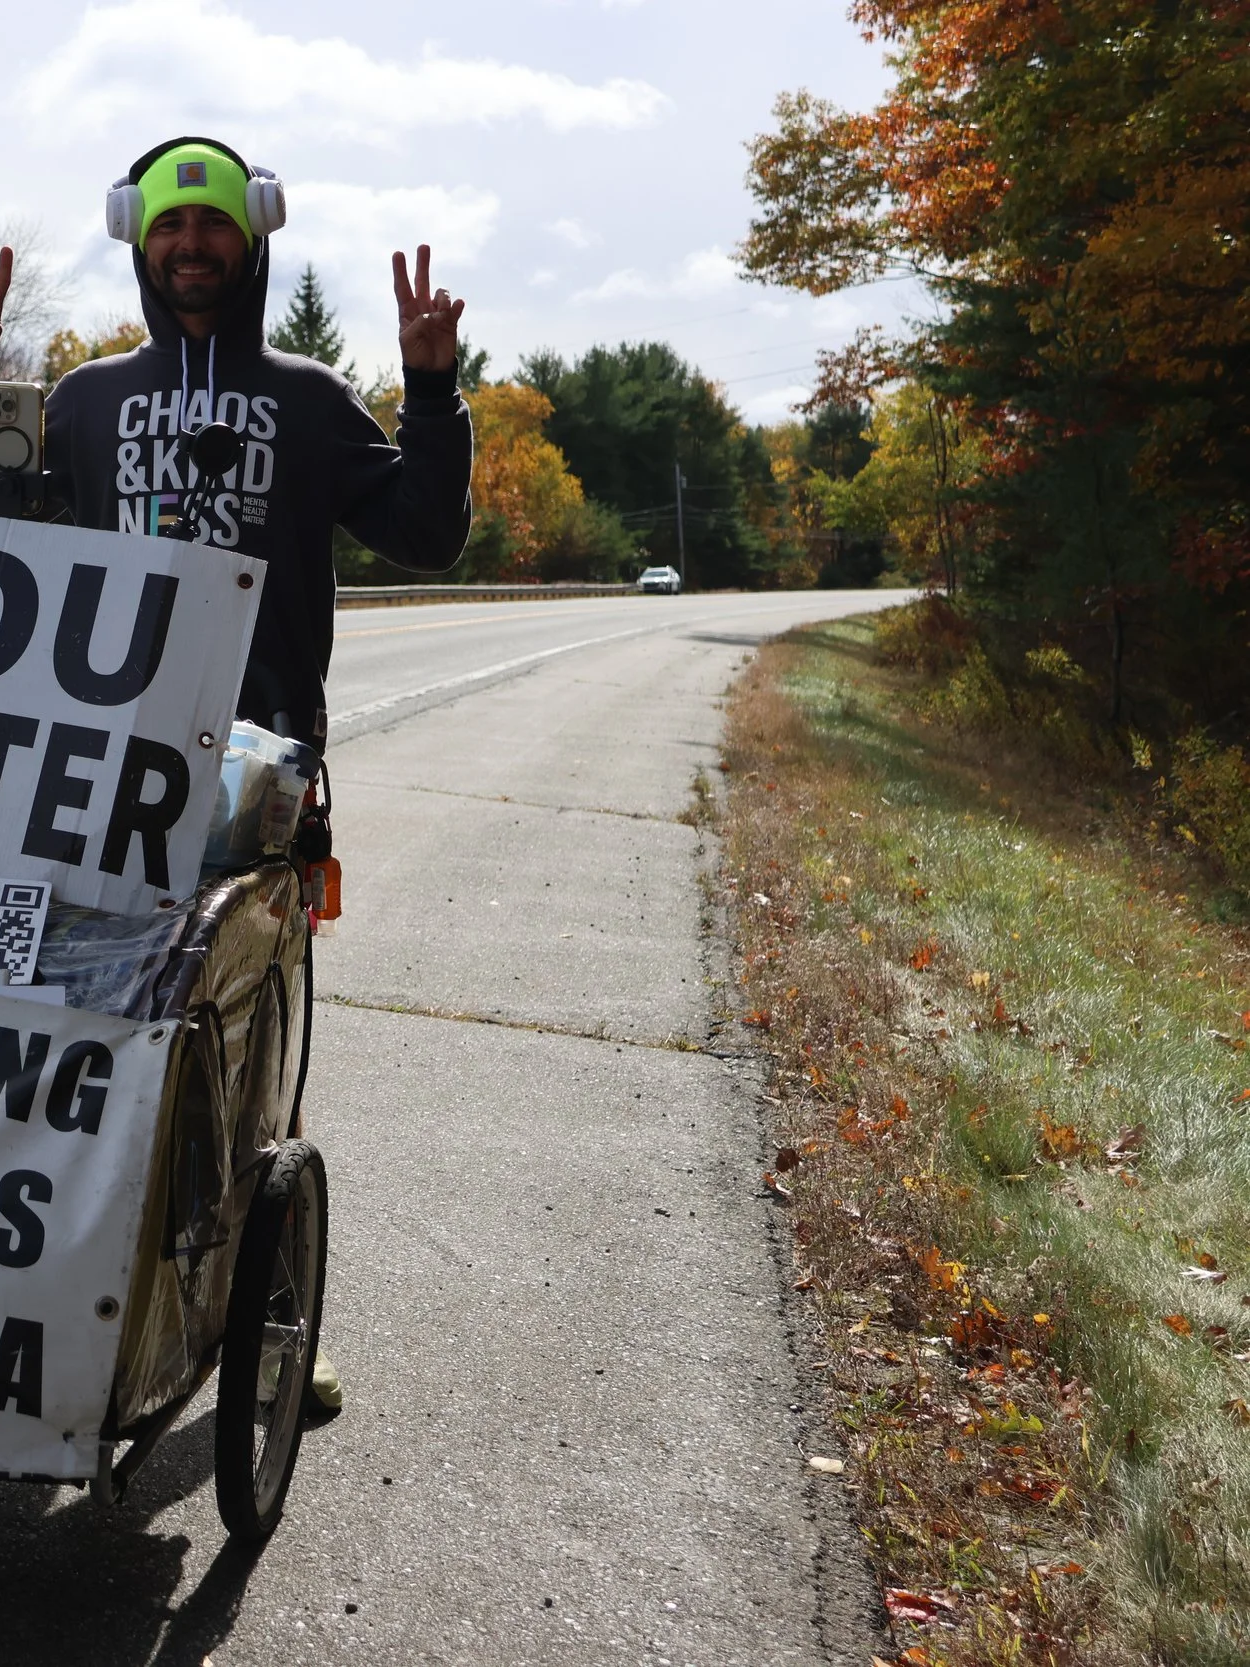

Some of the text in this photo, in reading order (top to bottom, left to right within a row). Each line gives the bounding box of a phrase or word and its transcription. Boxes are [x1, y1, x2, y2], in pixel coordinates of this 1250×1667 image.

[118, 389, 278, 440] CHAOS
[243, 496, 269, 509] MENTAL
[242, 505, 267, 517] HEALTH
[118, 493, 240, 546] NESS
[241, 514, 266, 526] MATTERS
